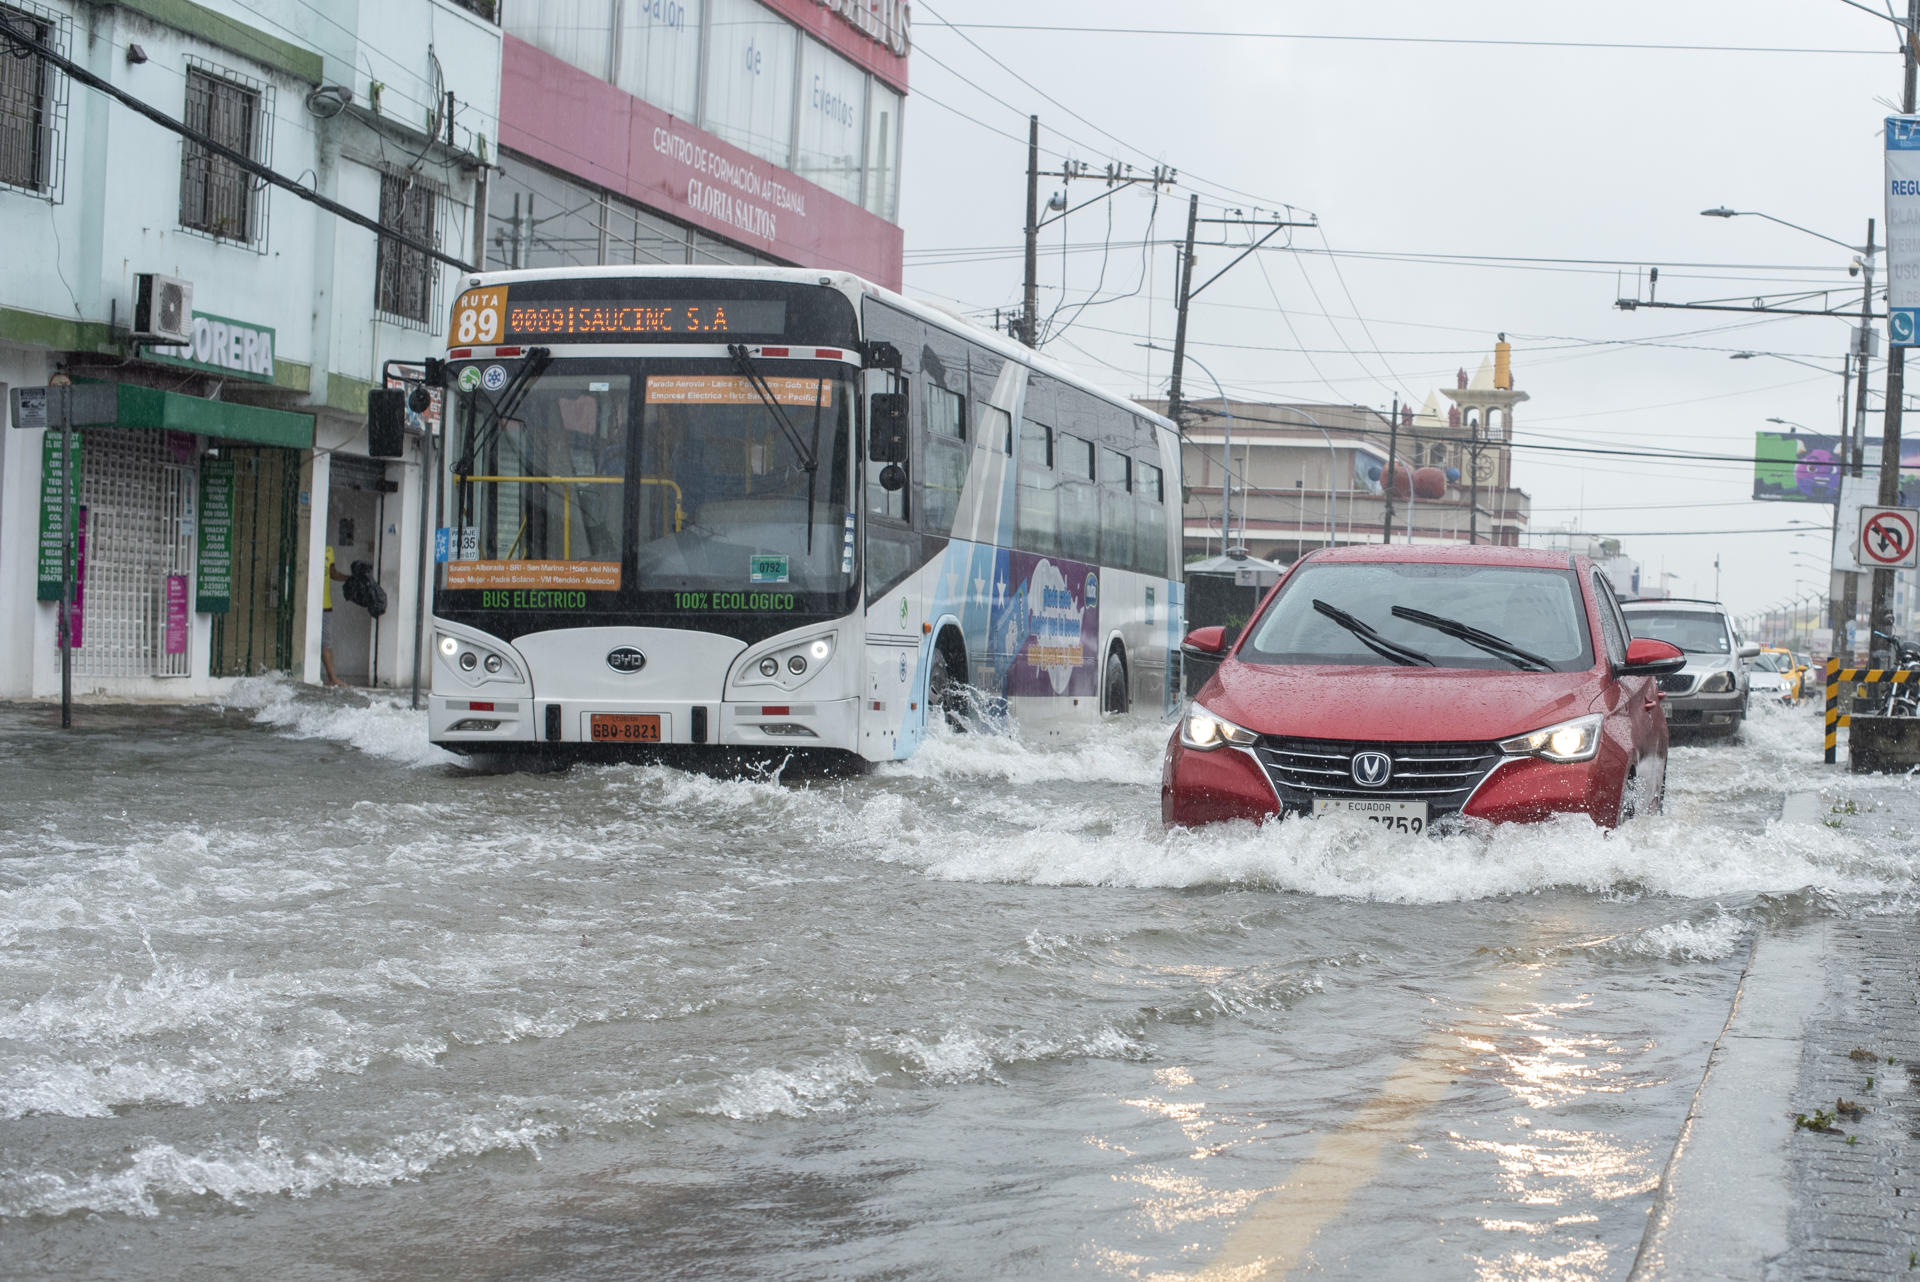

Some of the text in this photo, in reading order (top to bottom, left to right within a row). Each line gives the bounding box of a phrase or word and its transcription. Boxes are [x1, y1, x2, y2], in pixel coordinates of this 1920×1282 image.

[746, 37, 761, 74] de
[813, 75, 854, 128] Eventos
[653, 127, 693, 165] CENTRO
[694, 146, 707, 172] DE
[708, 152, 761, 196] FORMACIÓN
[687, 178, 776, 242] GLORIA SALTOS
[461, 294, 499, 307] RUTA
[458, 308, 498, 342] 89
[759, 562, 781, 574] 0792
[483, 587, 586, 609] BUS ELÉCTRICO
[674, 588, 794, 610] 100% ECOLÓGICO
[611, 654, 642, 666] BYD
[1348, 802, 1391, 811] ECUADOR
